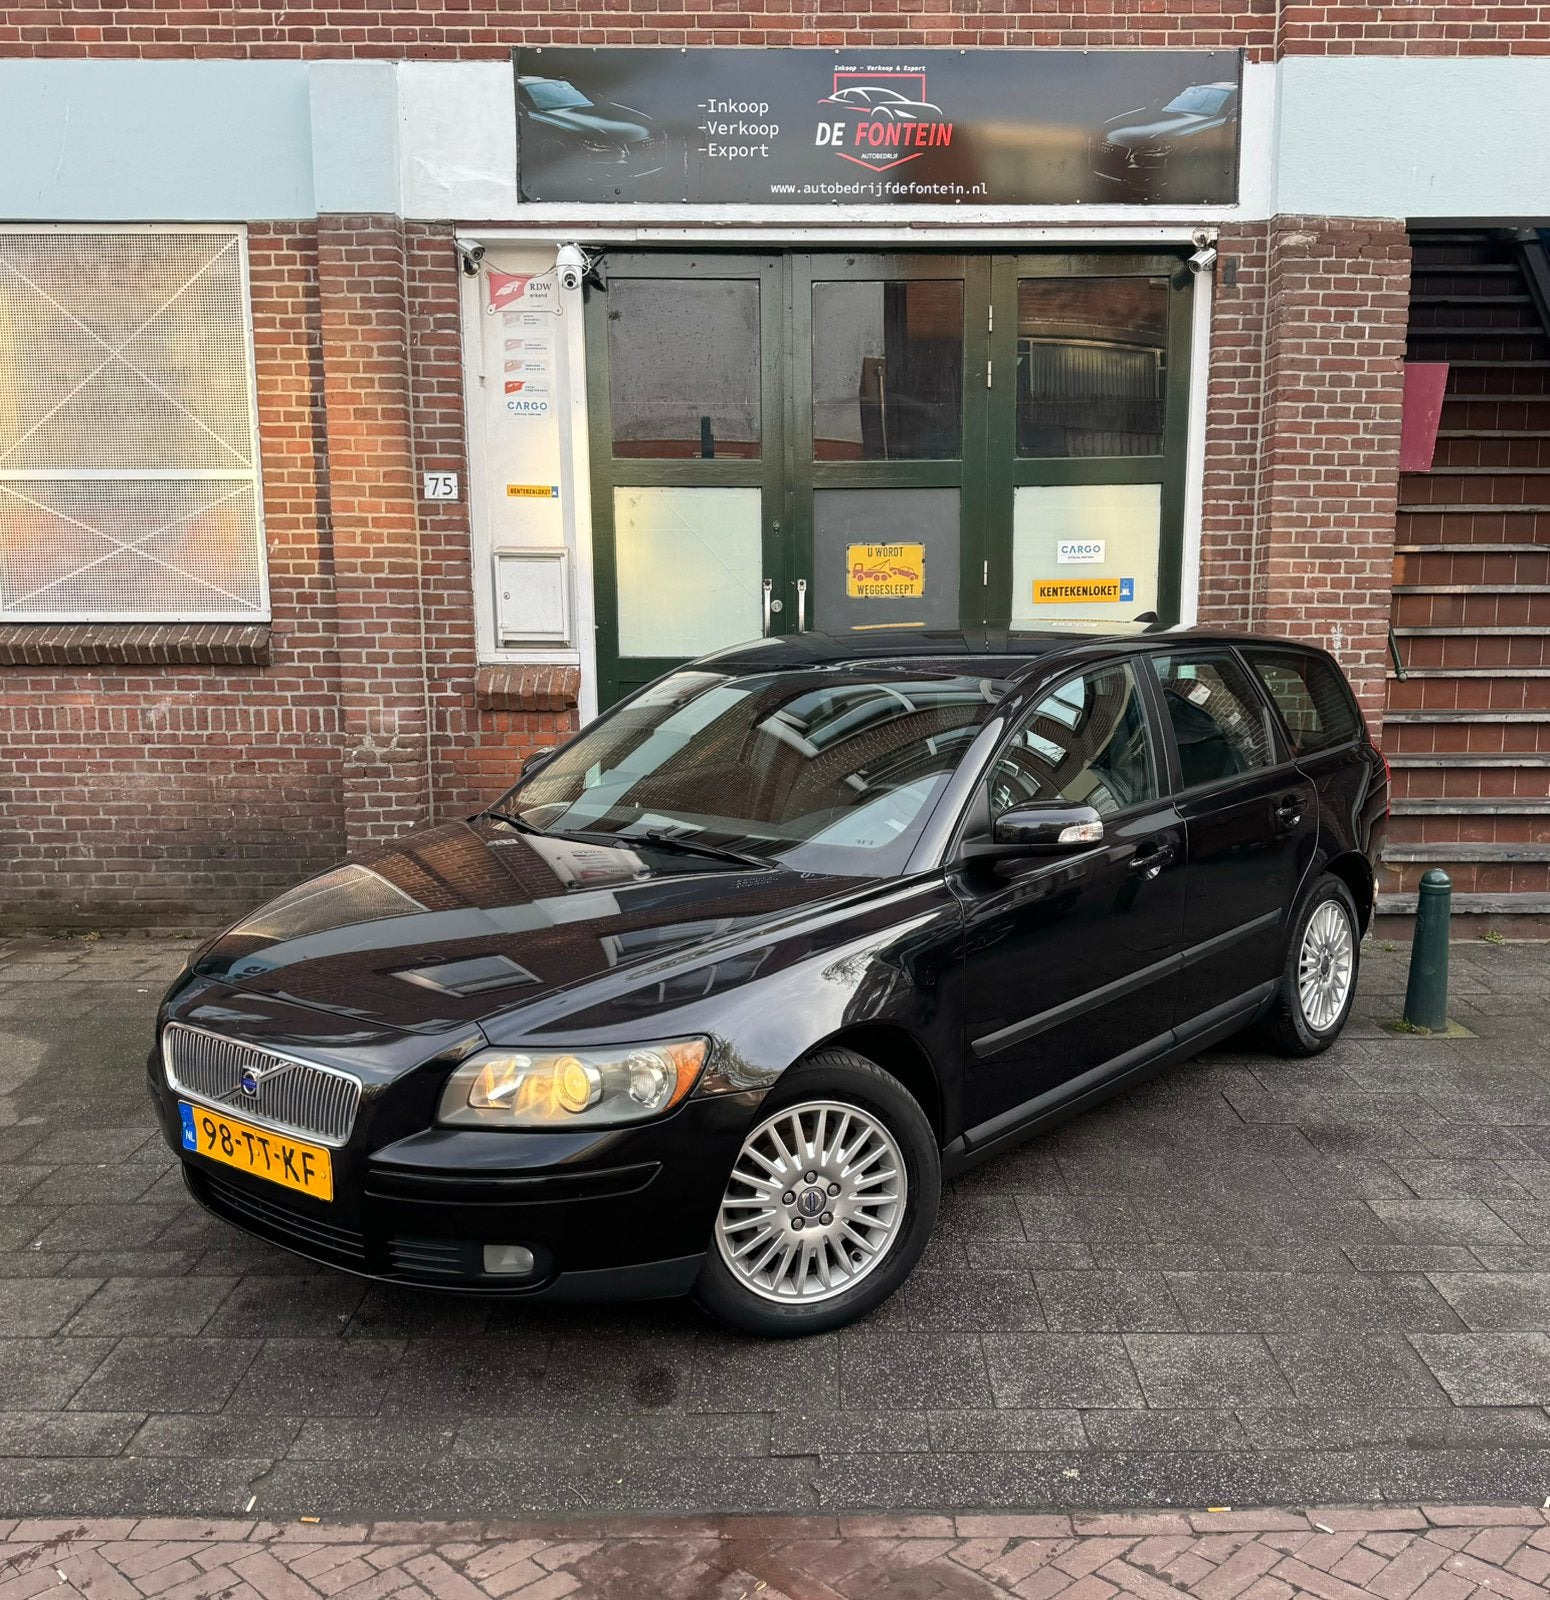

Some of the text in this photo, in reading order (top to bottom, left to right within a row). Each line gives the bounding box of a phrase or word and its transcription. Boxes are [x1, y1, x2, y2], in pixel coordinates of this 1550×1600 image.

[833, 64, 856, 72] Inkoop
[866, 64, 894, 72] Verkoop
[903, 64, 926, 72] Export
[697, 98, 769, 117] -Inkoop
[697, 120, 780, 139] -Verkoop
[815, 122, 953, 147] DE FONTEIN
[697, 143, 769, 161] -Export
[861, 152, 899, 160] AUTOBEDRIJF
[770, 182, 988, 197] www.autobedrijfdefontein.nl
[530, 283, 552, 291] RDW
[507, 401, 548, 411] CARGO
[428, 477, 453, 496] 75
[867, 546, 904, 558] U WORDT
[1061, 545, 1101, 554] CARGO
[857, 584, 915, 595] WEGGESLEEPT
[1040, 585, 1118, 598] KENTEKENLOKET
[184, 1129, 196, 1143] NL
[202, 1116, 316, 1186] 98-TT-KF
